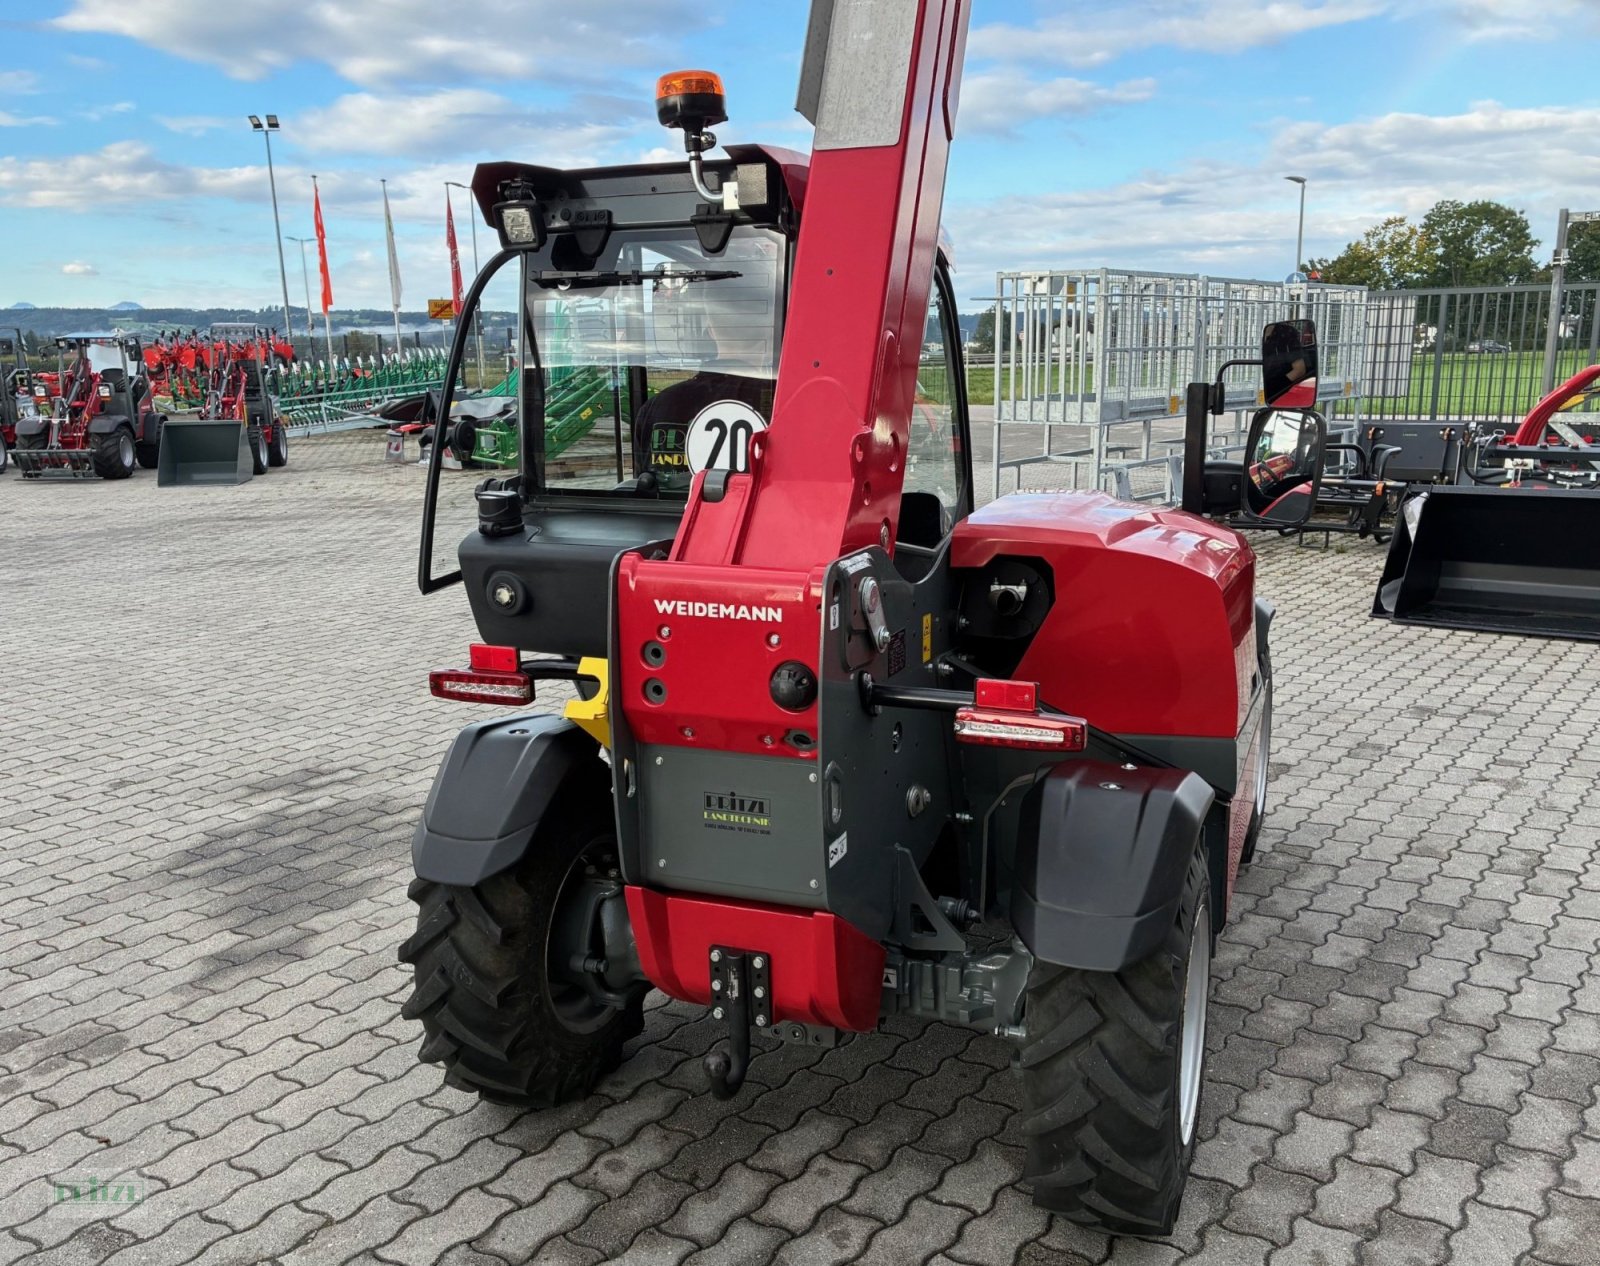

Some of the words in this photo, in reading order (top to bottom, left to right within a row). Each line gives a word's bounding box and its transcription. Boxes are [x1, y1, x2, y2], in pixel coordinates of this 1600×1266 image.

[652, 429, 686, 449] PR
[704, 418, 754, 473] 20
[653, 598, 783, 622] WEIDEMANN
